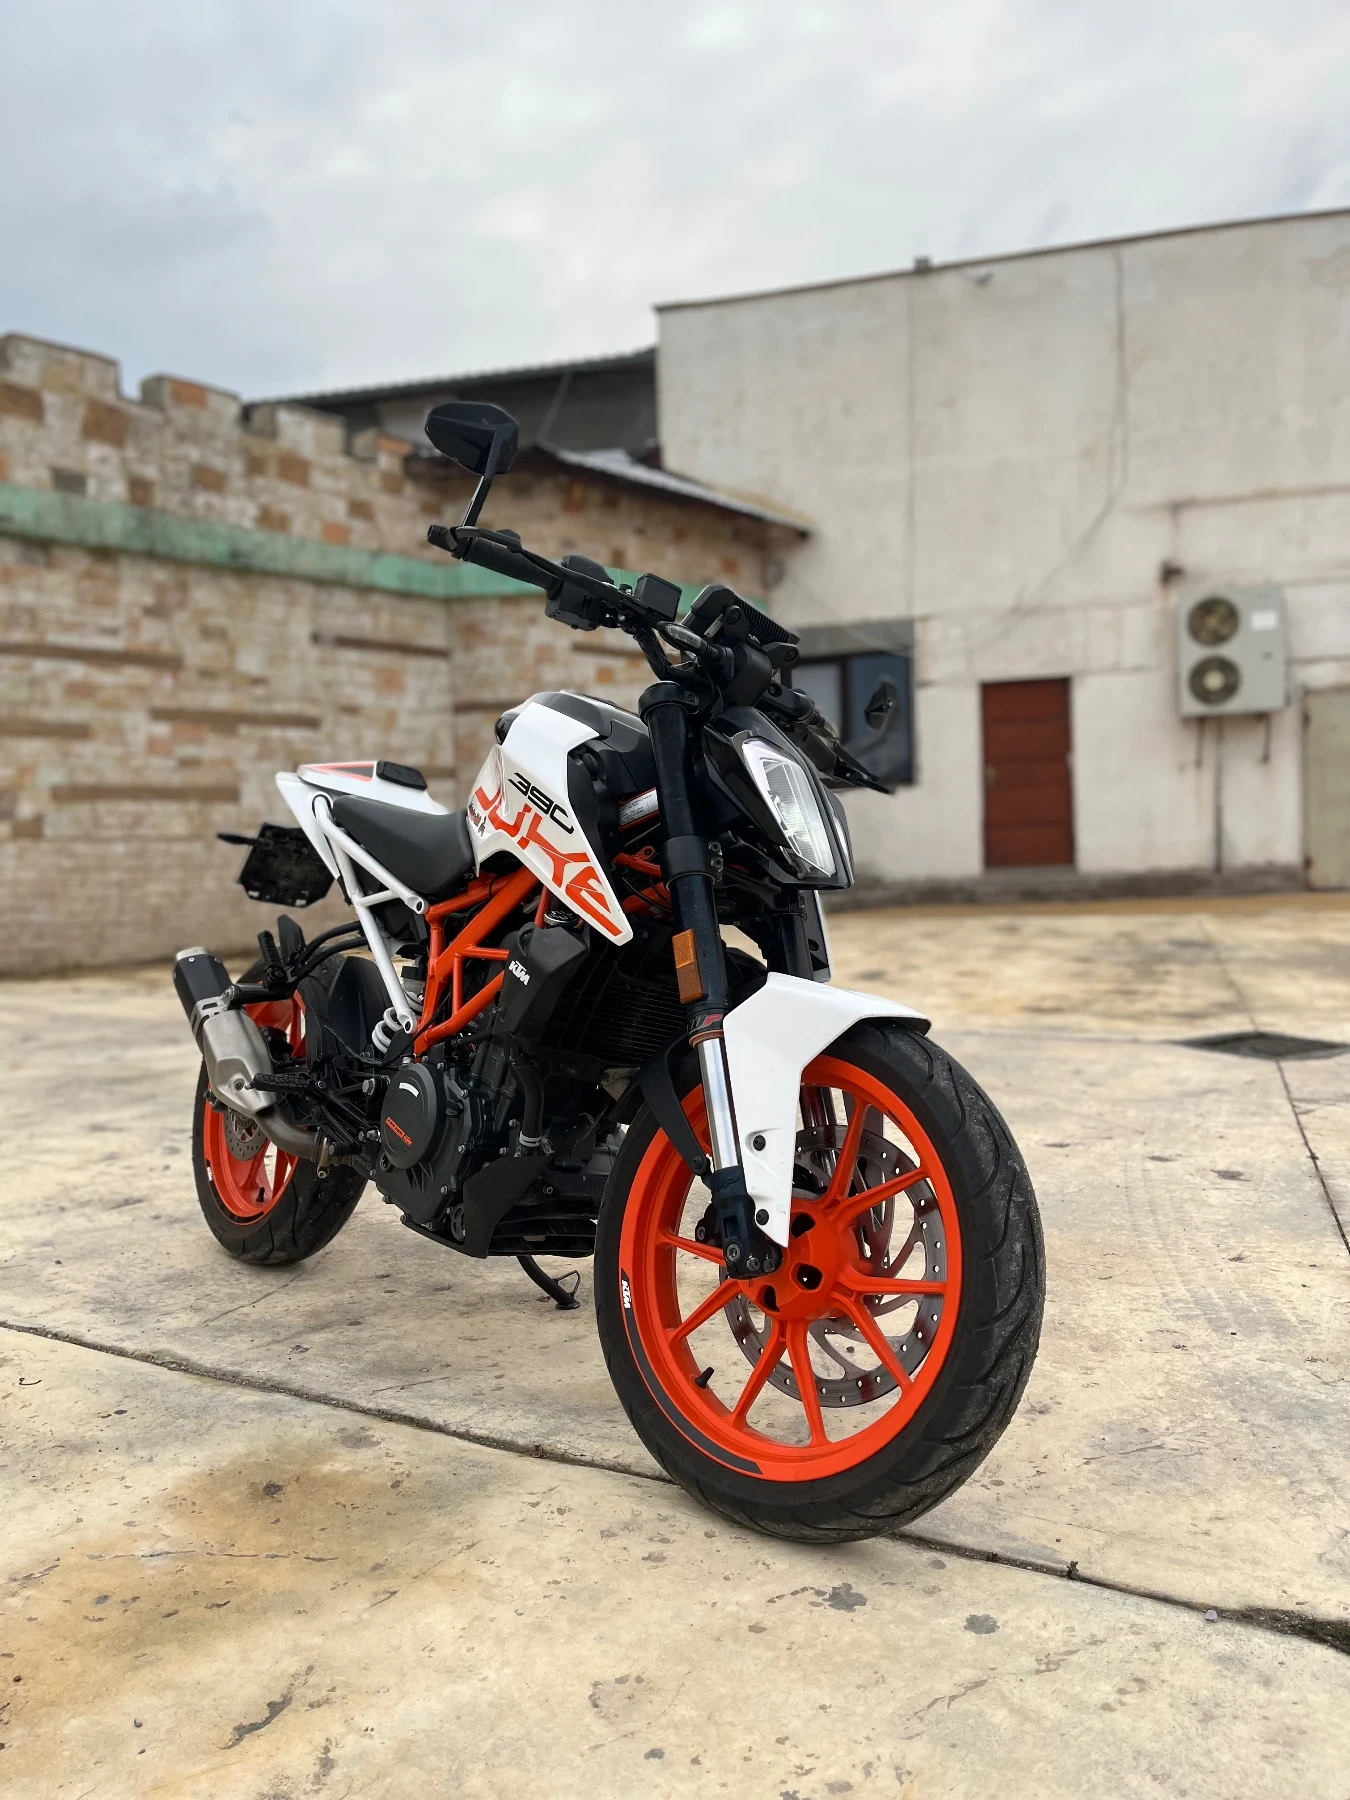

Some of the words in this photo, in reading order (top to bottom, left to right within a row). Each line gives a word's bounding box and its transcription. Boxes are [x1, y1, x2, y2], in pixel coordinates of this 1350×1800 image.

[508, 772, 574, 835] 390
[508, 960, 530, 986] KTM
[622, 1279, 632, 1308] KTM
